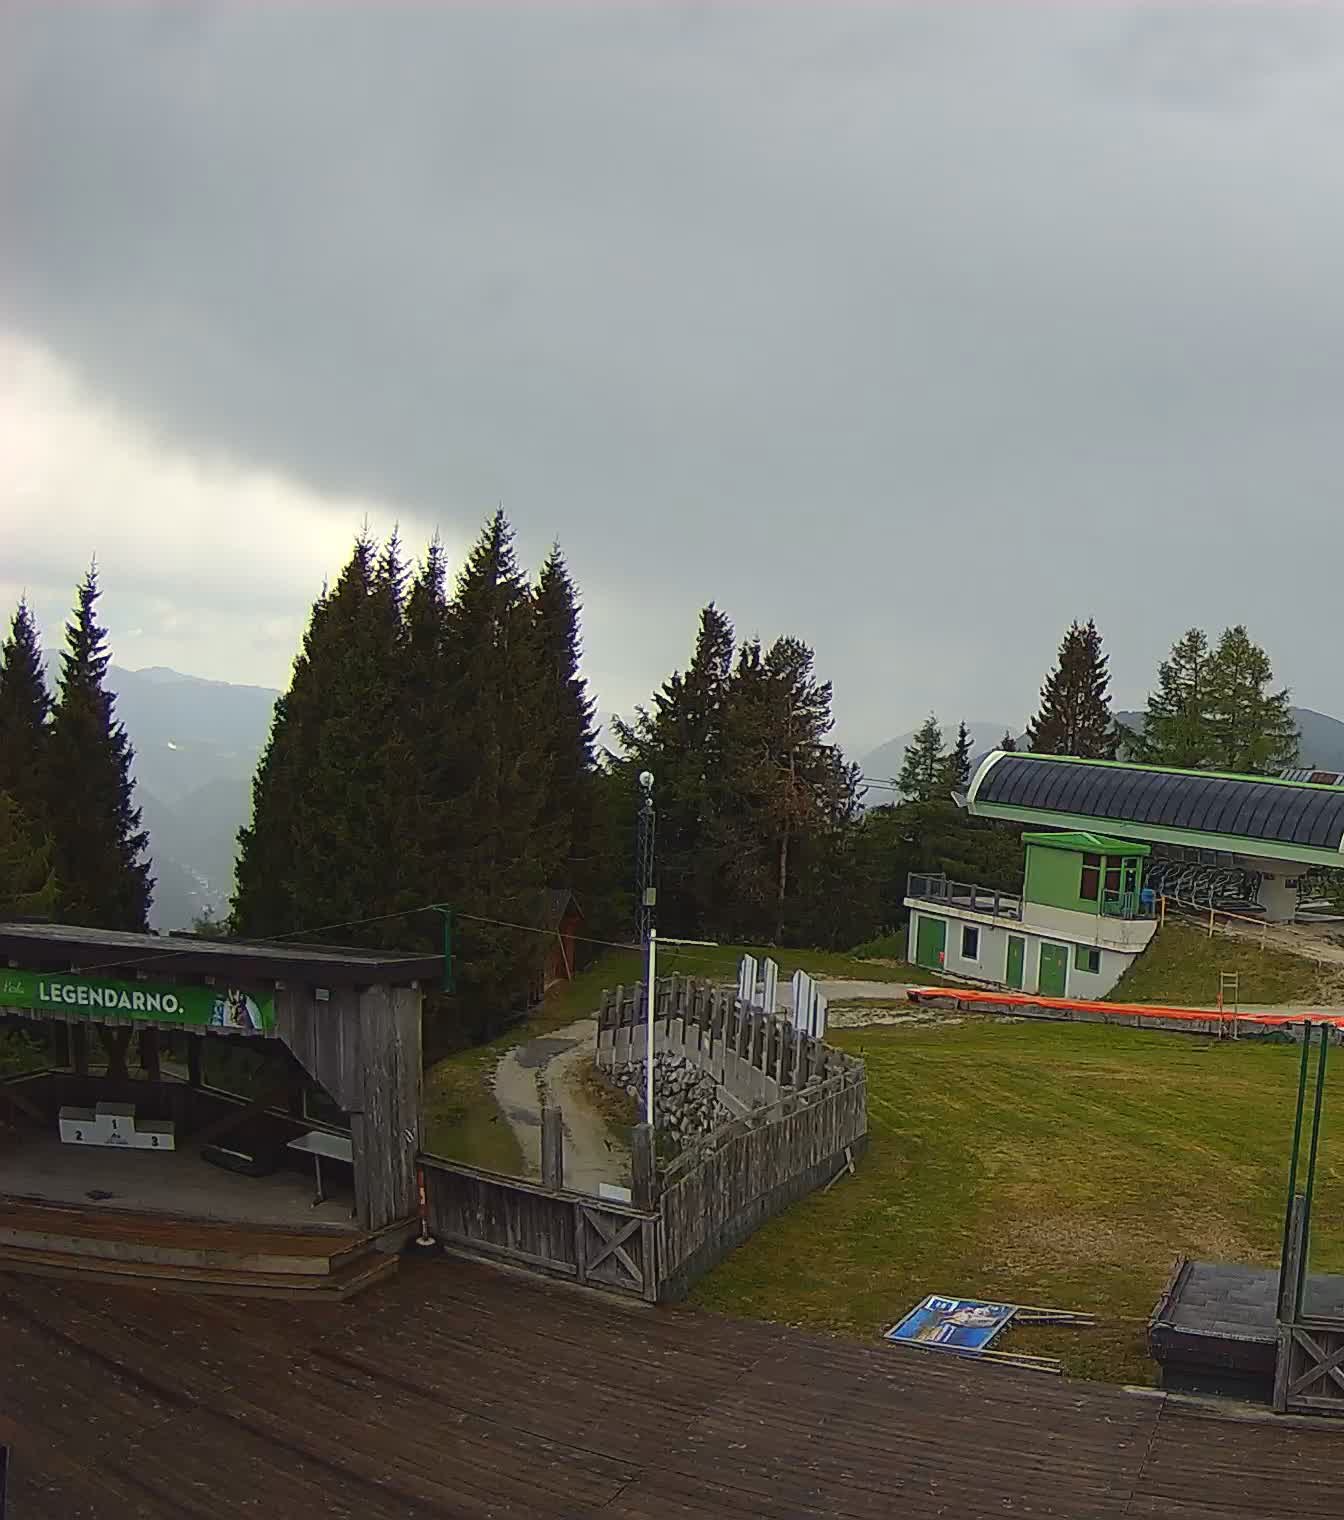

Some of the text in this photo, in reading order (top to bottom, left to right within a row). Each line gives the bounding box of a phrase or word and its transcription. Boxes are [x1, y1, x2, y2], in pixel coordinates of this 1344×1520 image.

[39, 982, 184, 1014] LEGENDARNO.
[111, 1119, 117, 1129] 1
[151, 1136, 159, 1147] 3
